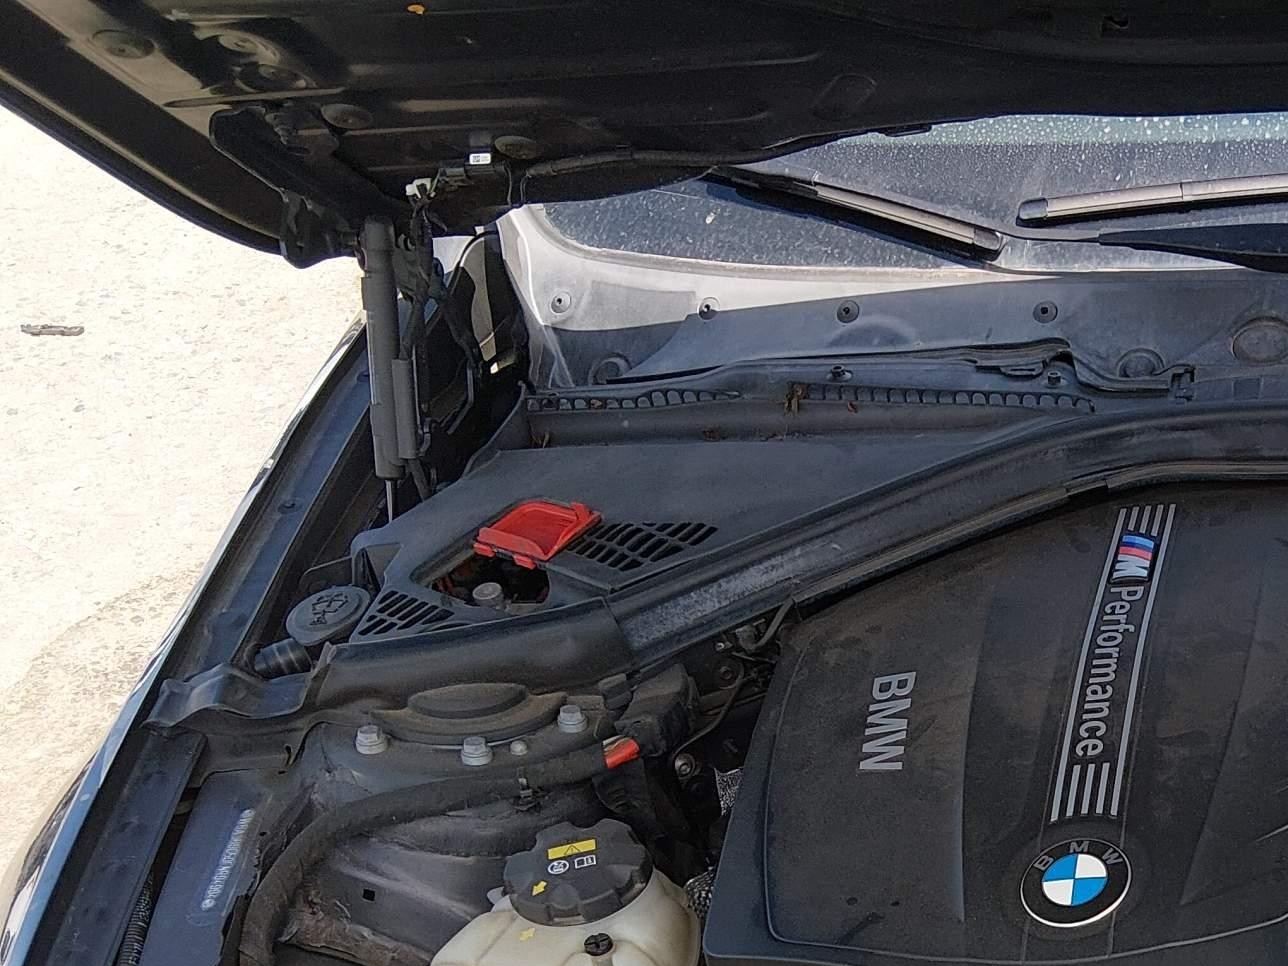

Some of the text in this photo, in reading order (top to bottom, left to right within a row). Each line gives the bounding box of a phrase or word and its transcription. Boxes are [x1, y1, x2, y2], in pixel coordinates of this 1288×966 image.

[859, 671, 917, 770] BMW
[1075, 586, 1145, 757] Performance
[1033, 840, 1124, 871] BMW
